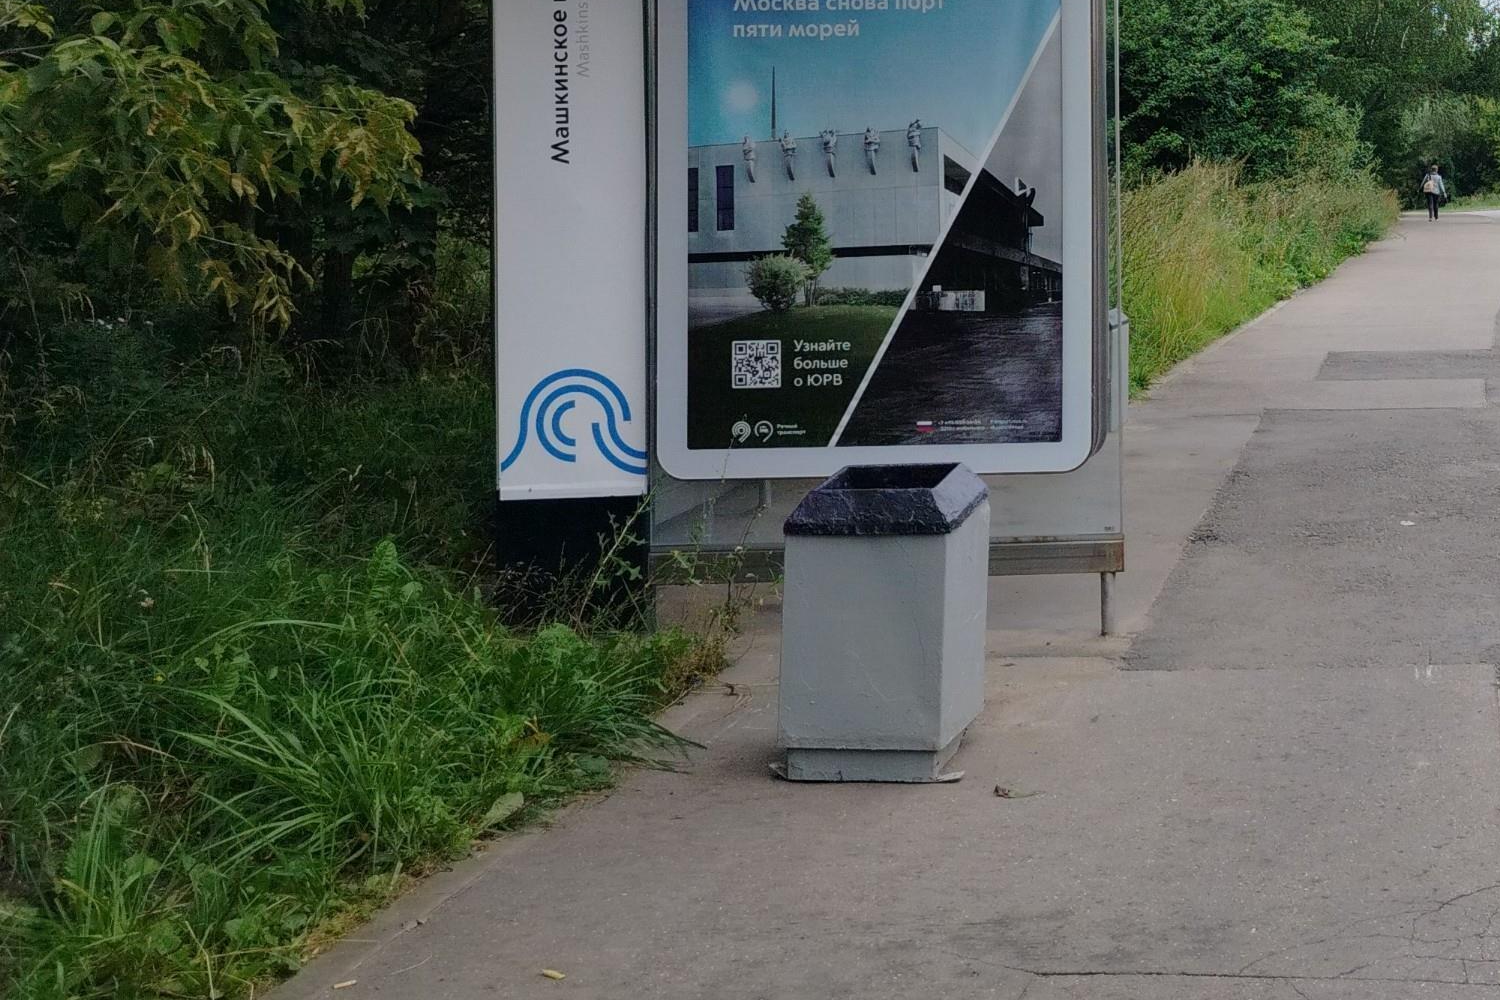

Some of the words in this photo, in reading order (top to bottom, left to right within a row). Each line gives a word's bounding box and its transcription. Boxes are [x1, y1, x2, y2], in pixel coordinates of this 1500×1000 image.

[733, 23, 782, 37] пяти
[788, 19, 860, 39] морей
[551, 9, 570, 164] Машкинское
[793, 339, 851, 352] Узнайте
[793, 357, 848, 368] больше
[793, 378, 803, 387] о
[807, 374, 843, 386] ЮРВ
